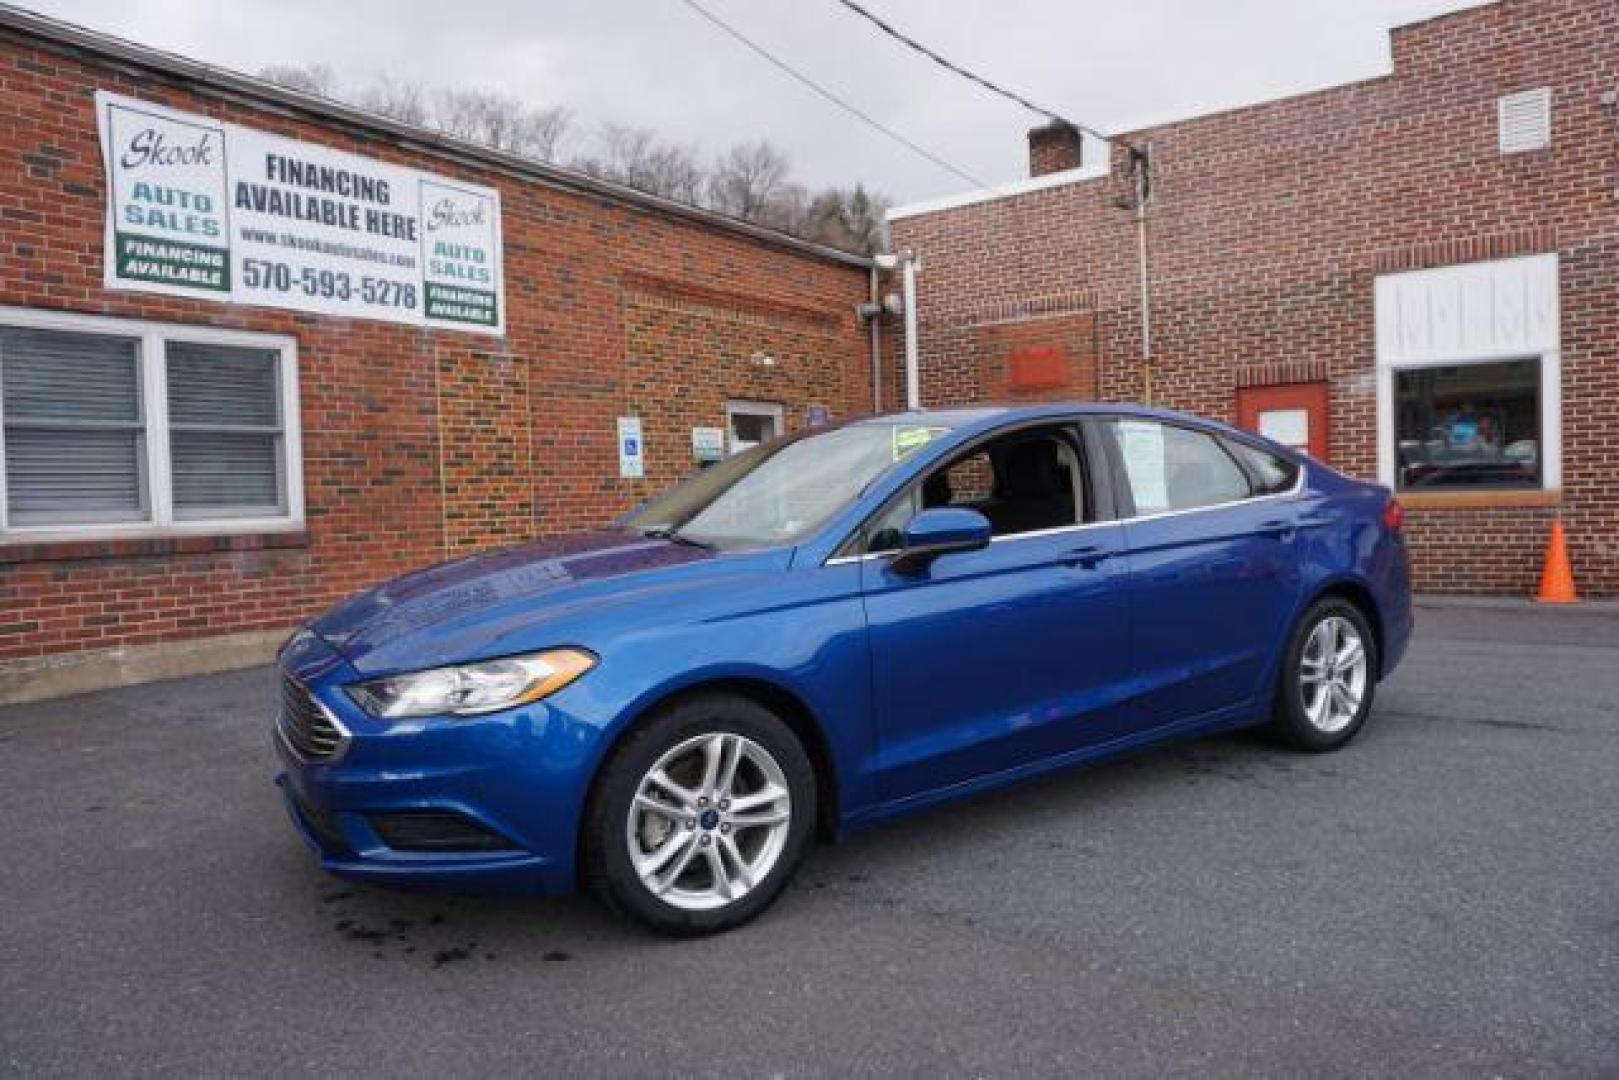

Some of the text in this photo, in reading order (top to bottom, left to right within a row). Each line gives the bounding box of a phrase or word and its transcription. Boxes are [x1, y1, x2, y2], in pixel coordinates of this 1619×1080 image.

[120, 128, 211, 169] Skook
[133, 182, 212, 213] AUTO
[265, 153, 391, 206] FINANCING
[124, 205, 220, 236] SALES
[234, 181, 418, 242] AVAILABLE HERE
[125, 240, 224, 267] FINANCING
[125, 259, 222, 285] AVAILABLE
[242, 257, 416, 309] 570-593-5278
